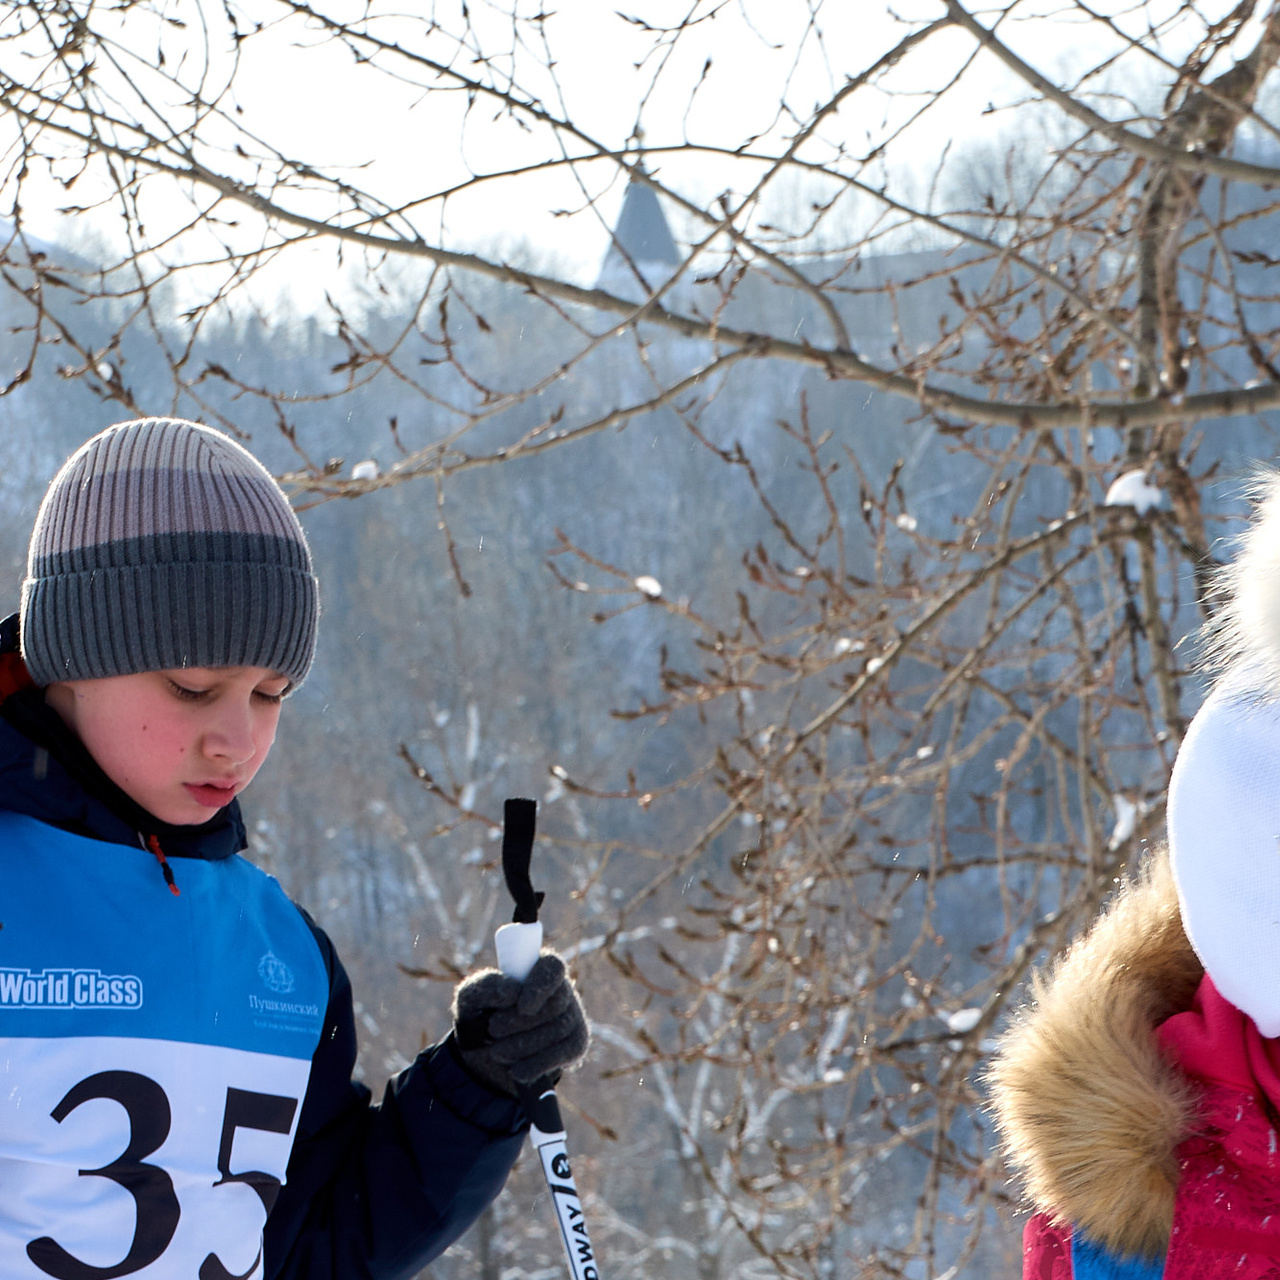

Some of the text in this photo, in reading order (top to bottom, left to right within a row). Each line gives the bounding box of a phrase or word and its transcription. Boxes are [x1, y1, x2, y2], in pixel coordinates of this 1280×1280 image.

[0, 973, 138, 1005] World Class
[248, 994, 319, 1017] Пушкинский
